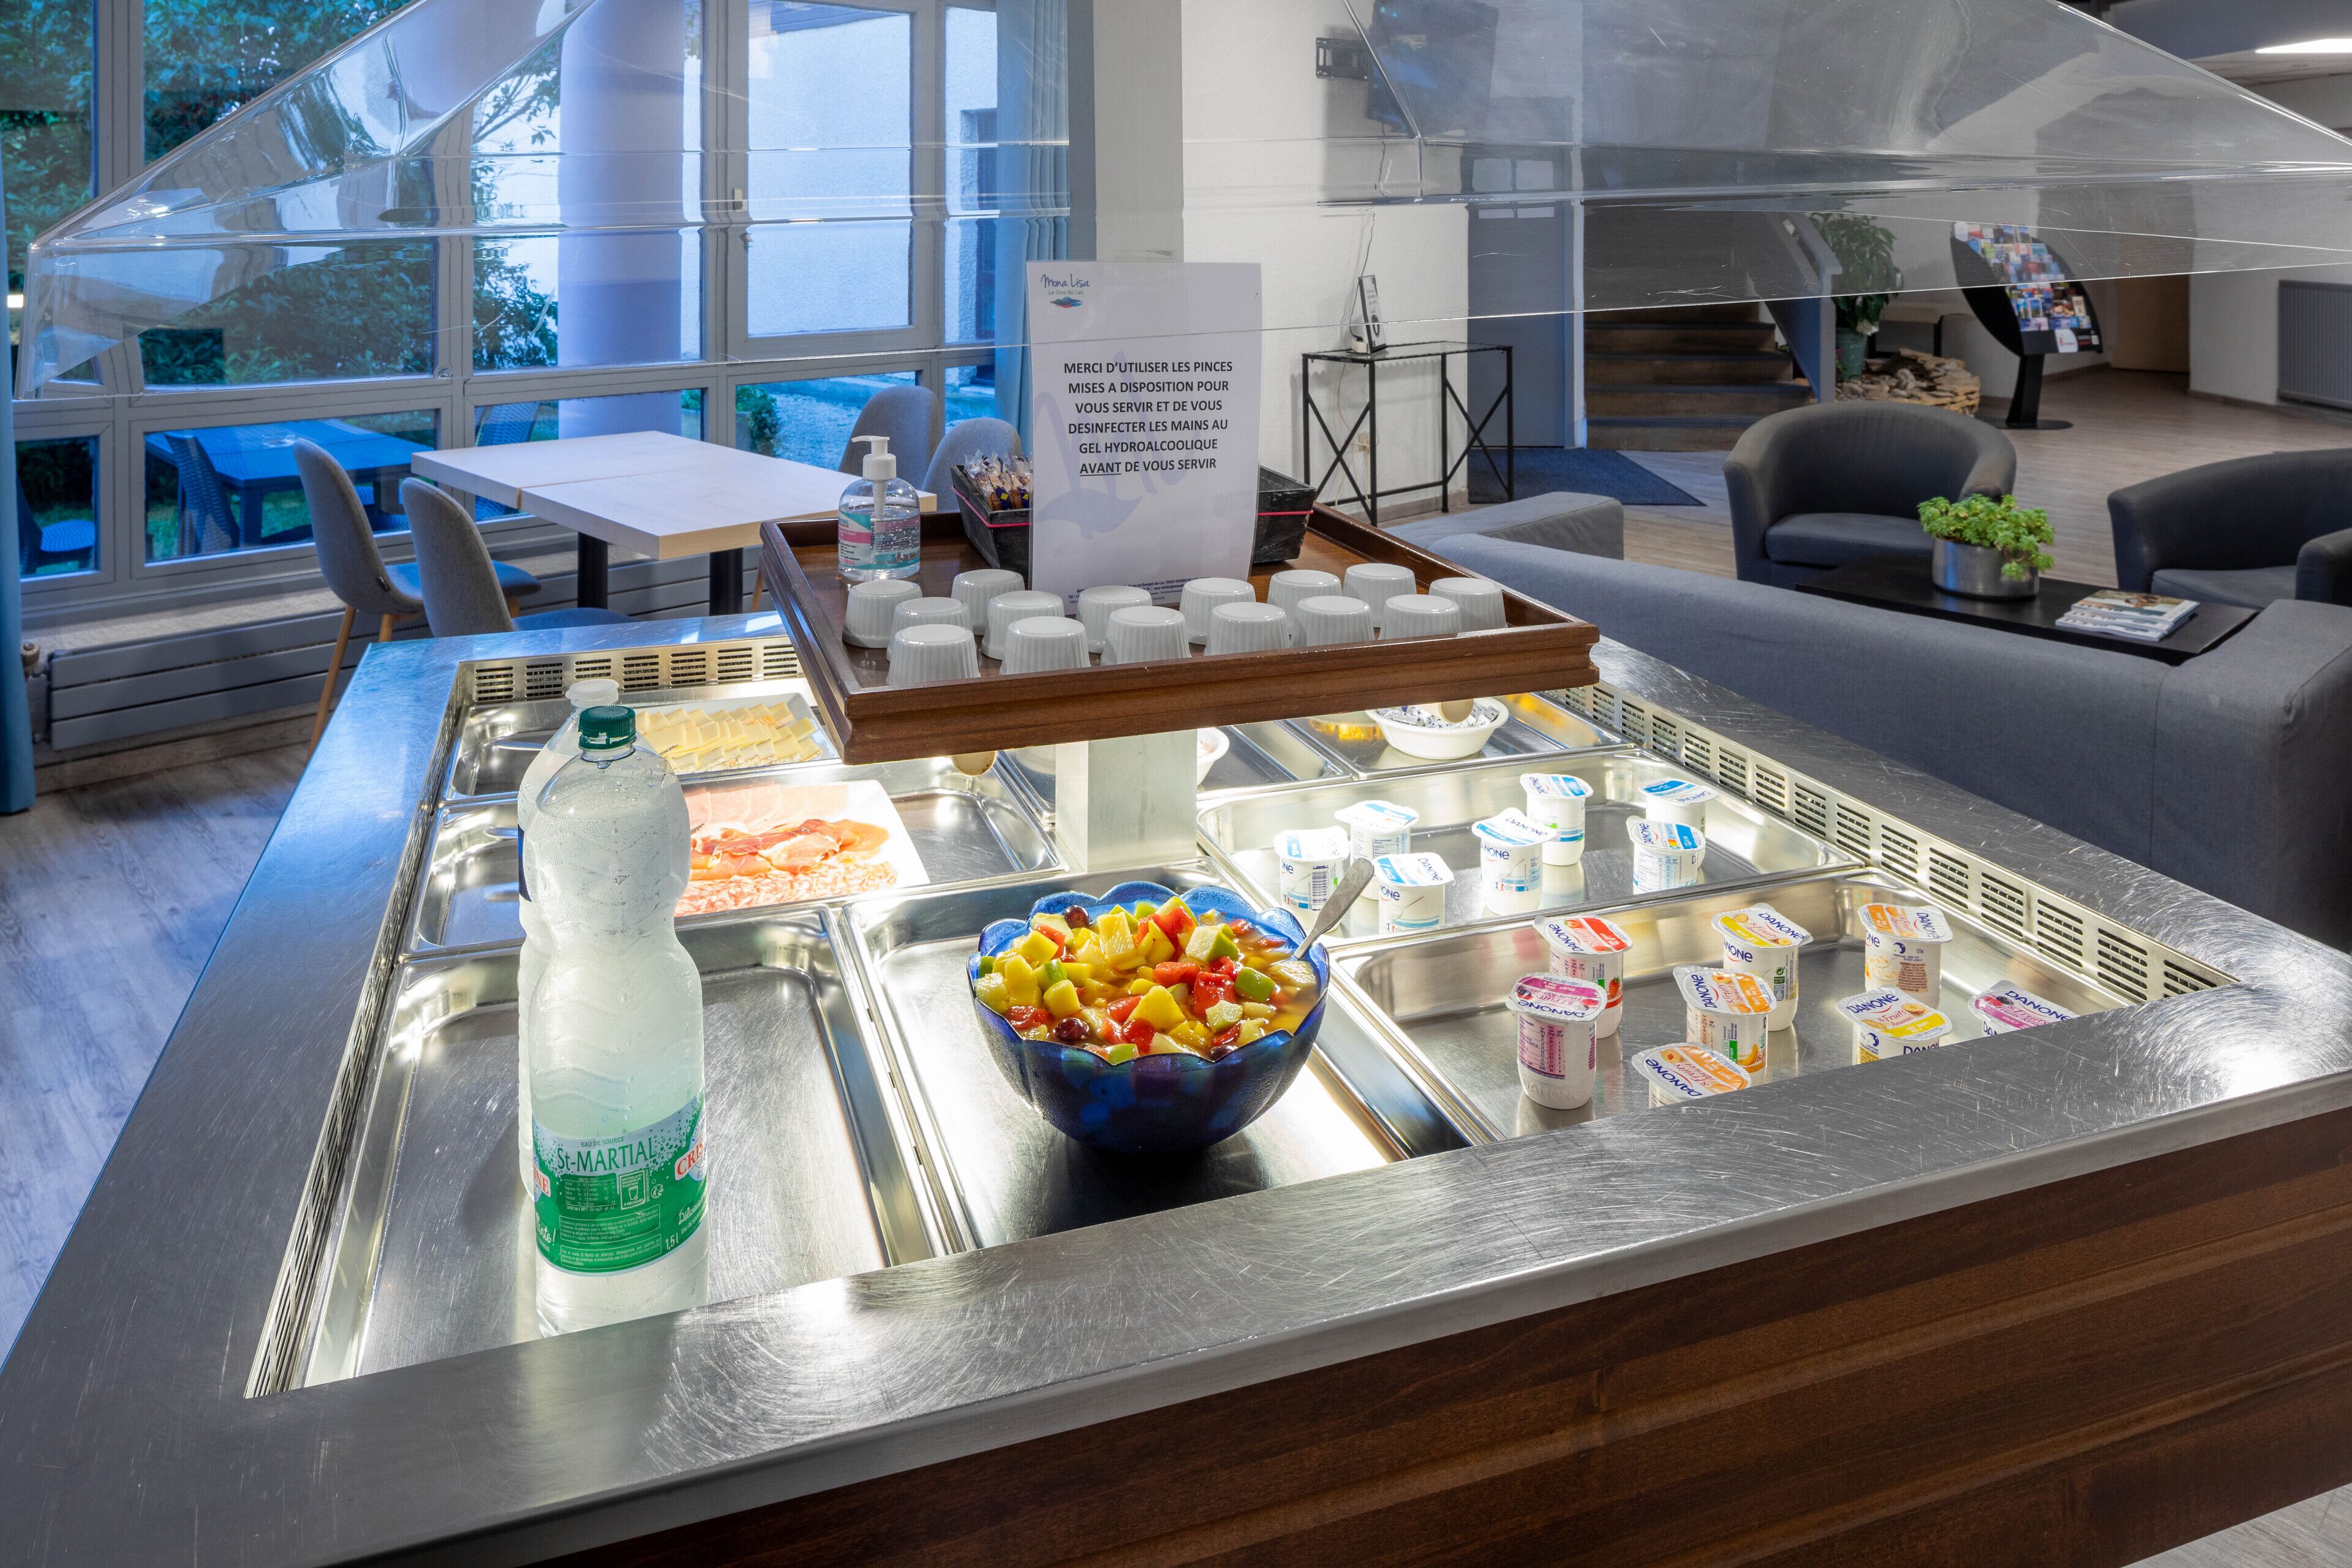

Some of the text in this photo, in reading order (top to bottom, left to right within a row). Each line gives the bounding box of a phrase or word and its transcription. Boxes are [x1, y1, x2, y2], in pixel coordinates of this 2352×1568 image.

[1041, 273, 1090, 288] Mona Lisa
[1064, 361, 1233, 374] MERCI D’UTILISER LES PINCES
[1068, 380, 1229, 393] MISES A DISPOSITION POUR
[1075, 400, 1223, 413] VOUS SERVIR ET DE VOUS
[1068, 419, 1228, 434] DESINFECTER LES MAINS AU
[1079, 439, 1218, 454] GEL HYDROALCOOLIQUE
[1079, 458, 1216, 475] AVANT DE VOUS SERVIR
[602, 1136, 625, 1146] SOURCE
[557, 1136, 657, 1172] St-MARTIAL
[665, 1234, 675, 1250] 1,5
